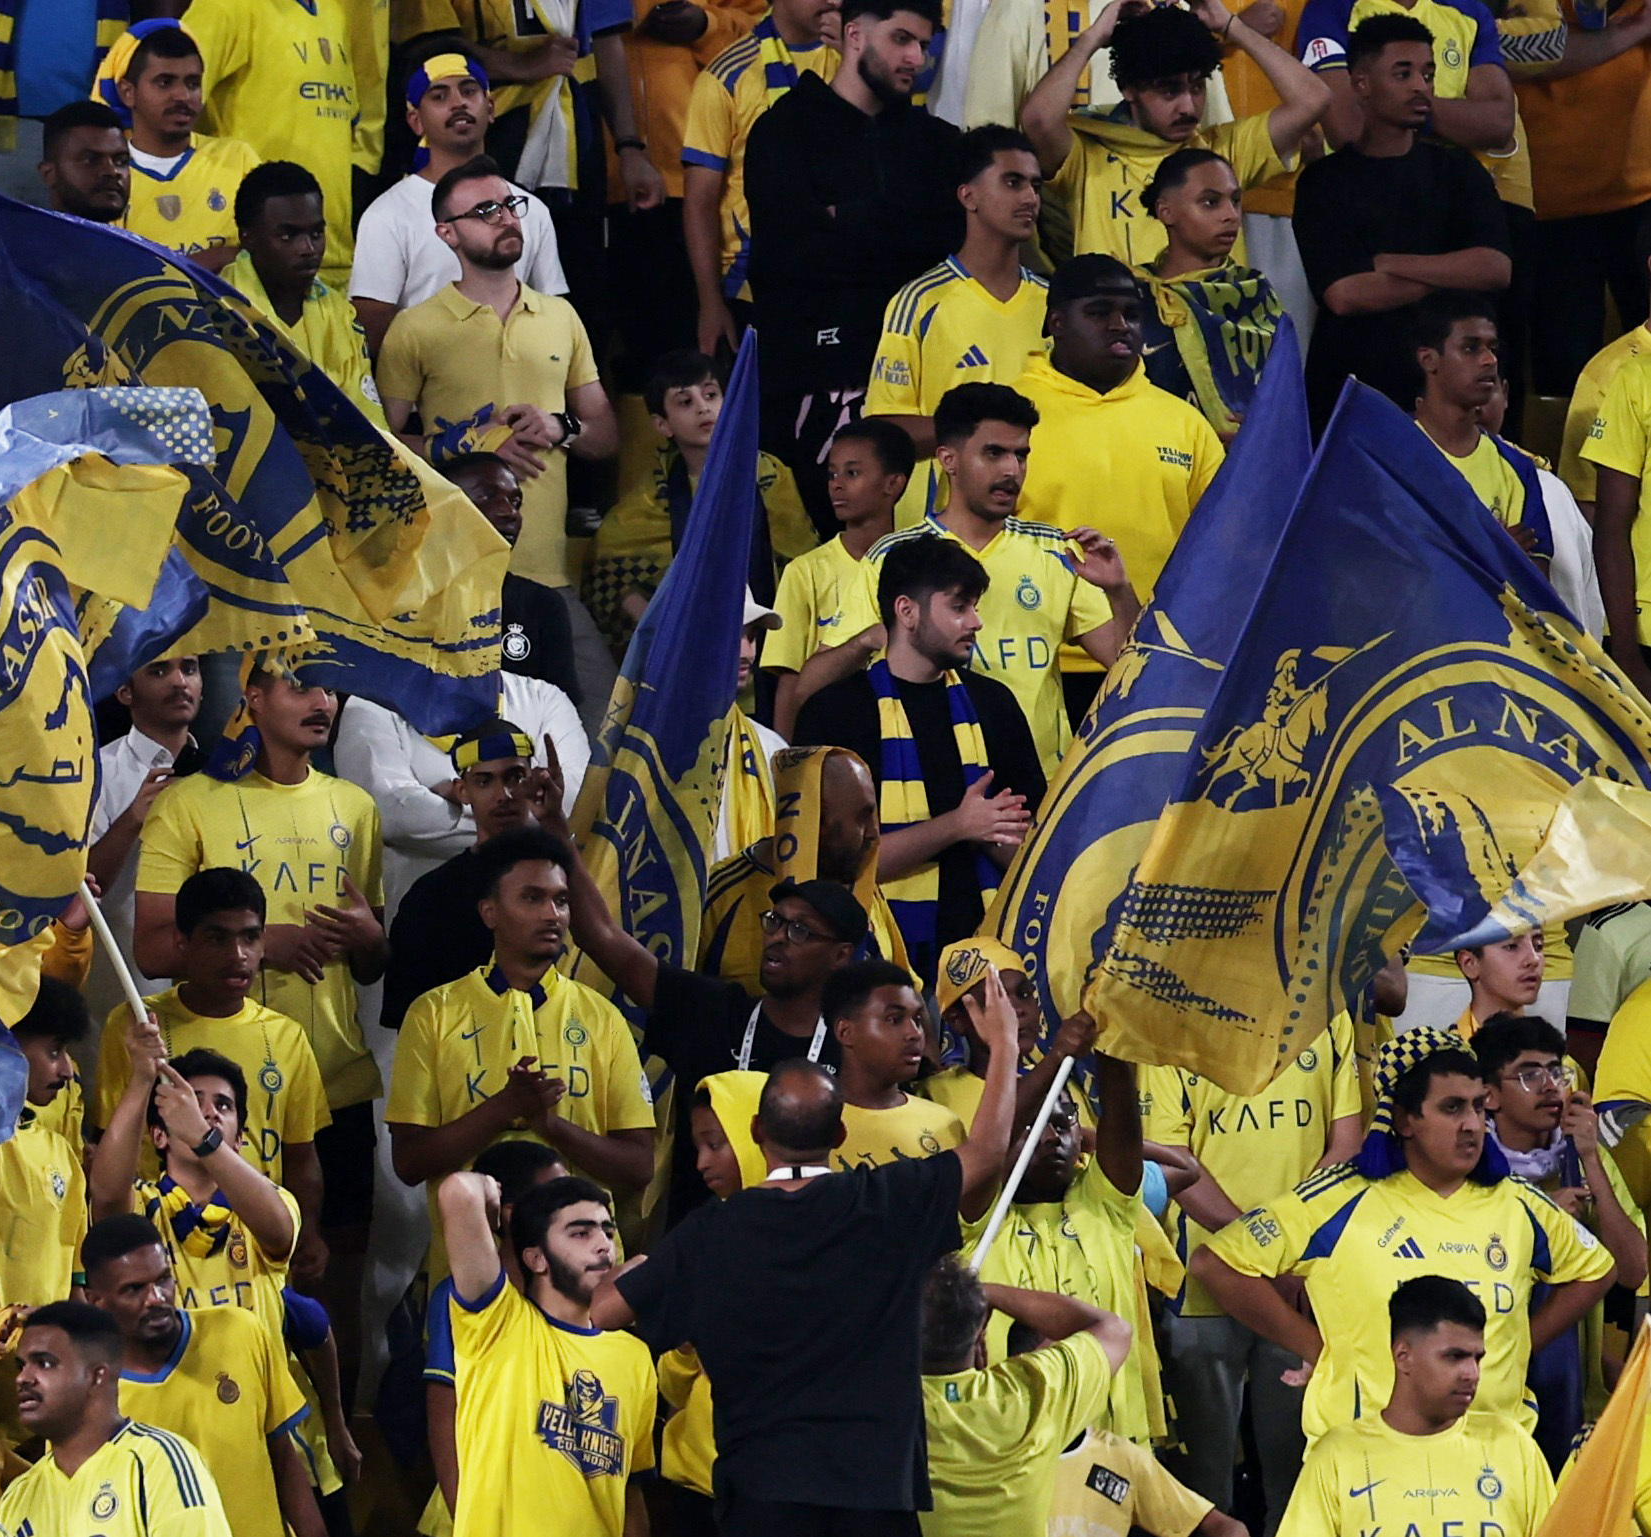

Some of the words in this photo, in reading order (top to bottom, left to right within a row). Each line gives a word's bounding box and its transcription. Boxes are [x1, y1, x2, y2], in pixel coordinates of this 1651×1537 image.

[189, 489, 282, 565] FOOT
[969, 636, 1050, 671] AFD
[1396, 696, 1477, 767] AL
[1208, 1098, 1314, 1135] KAFD
